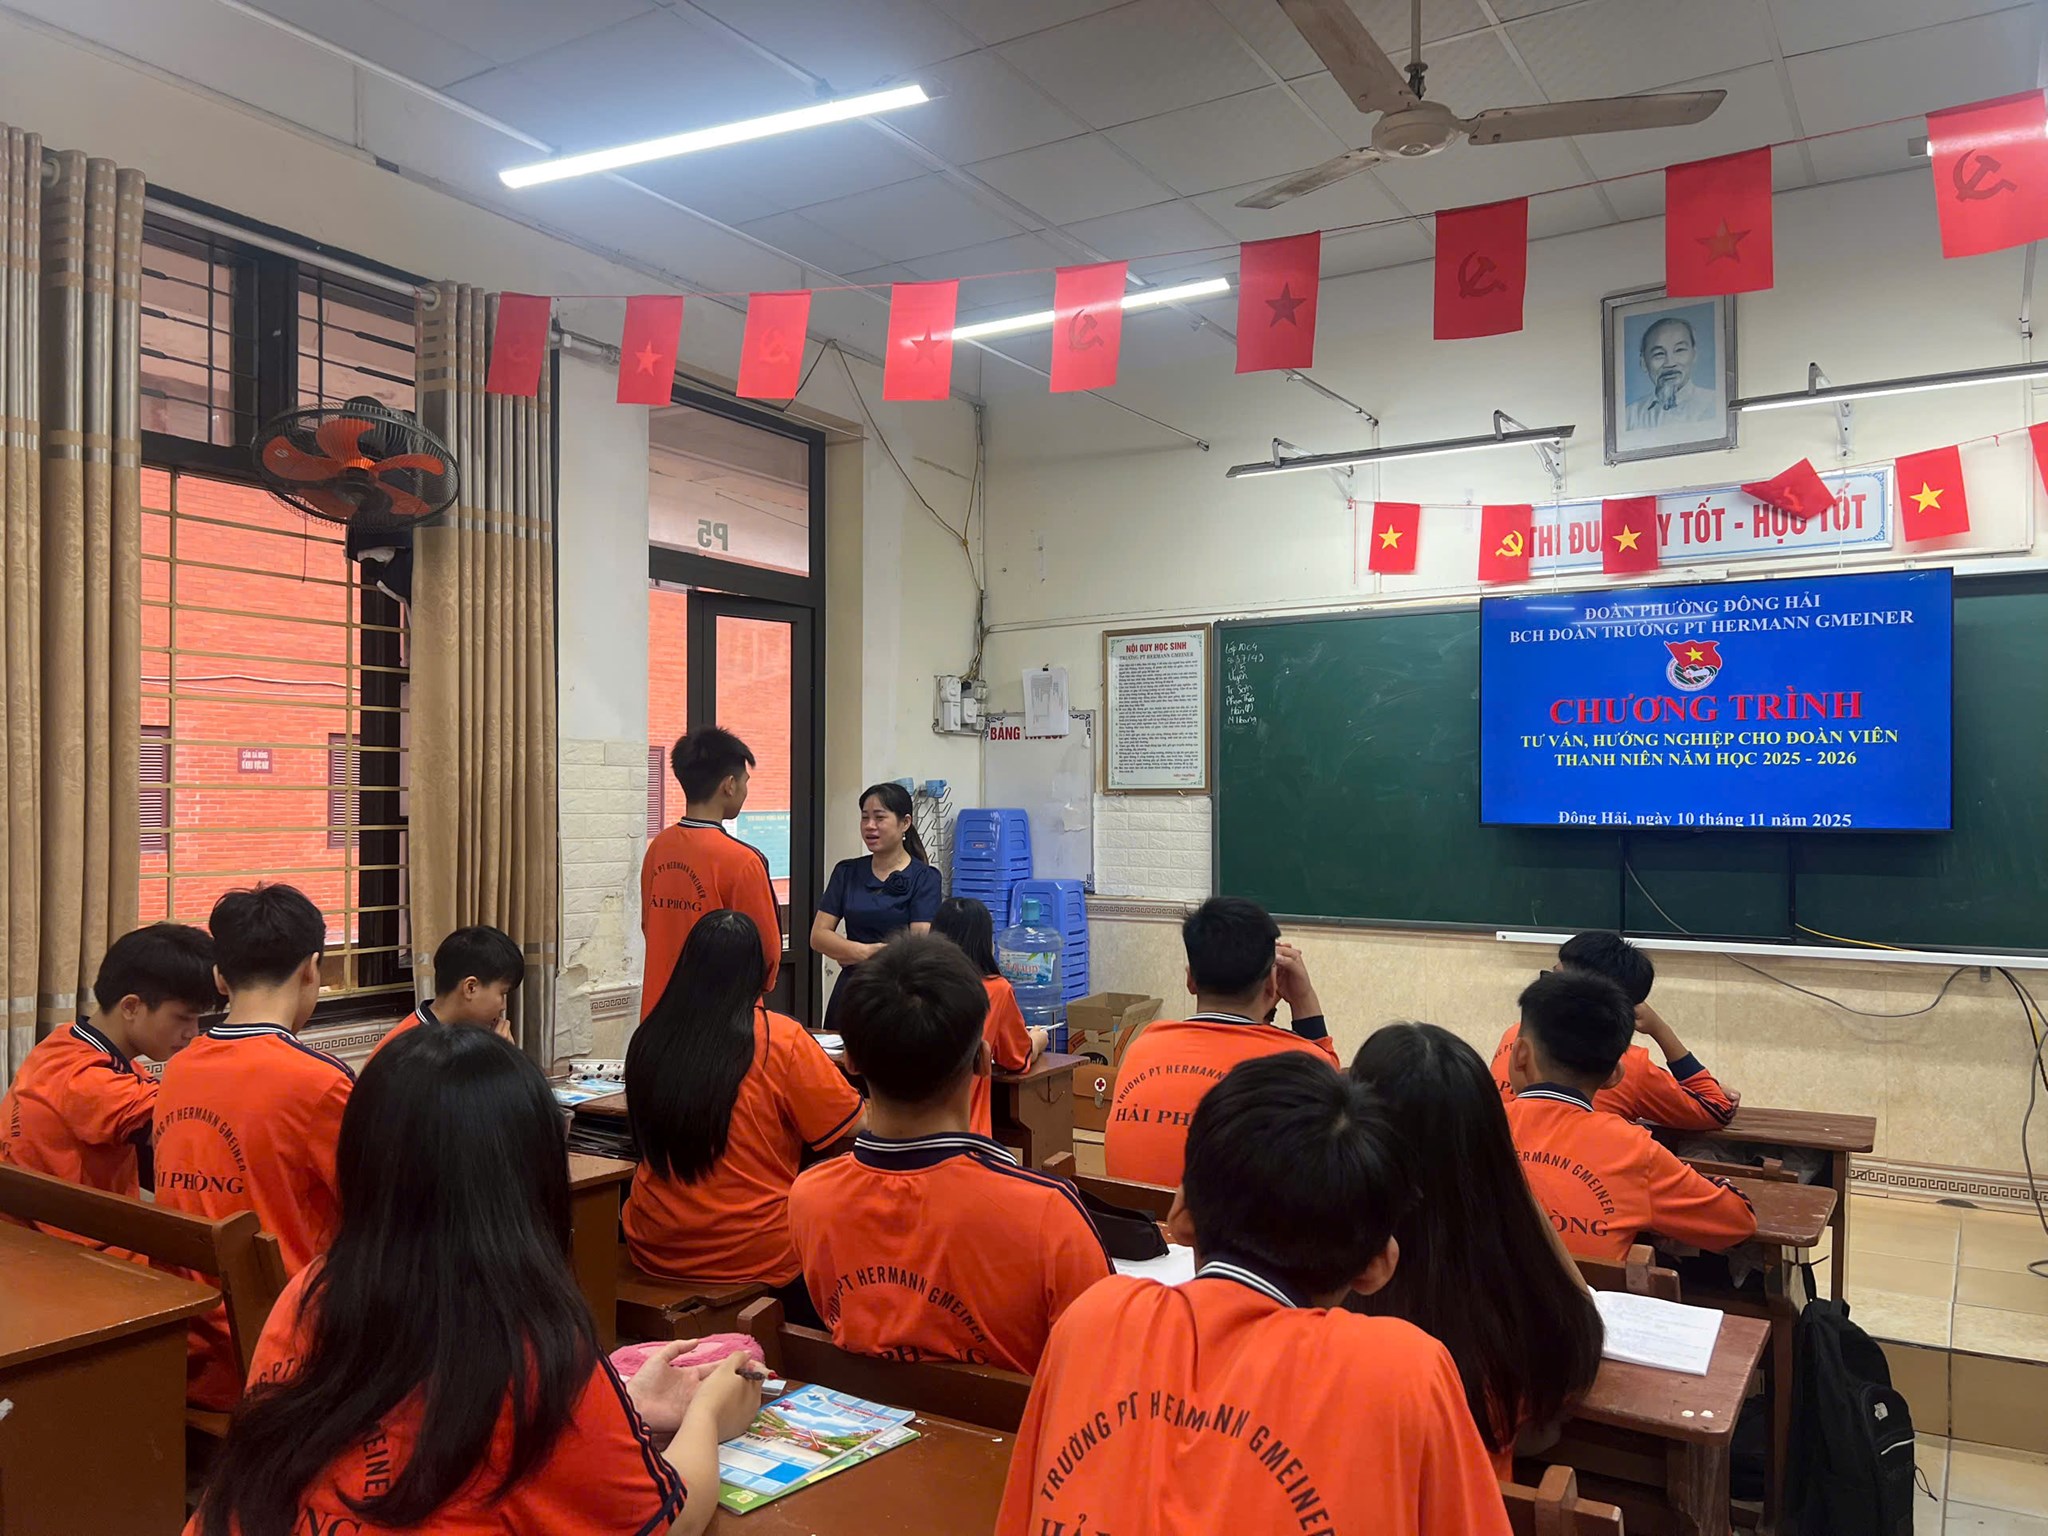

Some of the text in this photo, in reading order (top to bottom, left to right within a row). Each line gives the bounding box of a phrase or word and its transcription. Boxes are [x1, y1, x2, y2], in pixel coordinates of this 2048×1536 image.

[1680, 497, 1726, 546] TỐT
[1568, 520, 1603, 554] ĐU
[1584, 591, 1822, 620] ĐOÀN PHƯỜNG ĐÔNG HẢI
[1509, 610, 1915, 643] BCH ĐOÀN TRƯỜNG PT HERMANN GMEINER
[1126, 641, 1187, 654] NỘI QUY HỌC SINH
[1549, 685, 1863, 725] CHƯƠNG TRÌNH
[990, 721, 1021, 740] BẢNG
[1520, 726, 1899, 749] TƯ VẤN, HƯỚNG NGHIỆP CHO ĐOÀN VIÊN
[1554, 753, 1616, 767] THANH
[1620, 749, 1664, 767] NIÊN
[1668, 749, 1712, 766] NĂM
[1716, 751, 1758, 769] HỌC
[1762, 751, 1801, 766] 2025
[1816, 751, 1858, 765] 2026
[1557, 810, 1852, 827] Đông Hải, ngày 10 tháng 11 năm 2025
[650, 894, 664, 908] ẢI
[1149, 1066, 1162, 1077] PT
[1166, 1064, 1227, 1081] HERMANN
[177, 1106, 220, 1128] HERMANN
[1115, 1103, 1151, 1122] HẢI
[170, 1169, 245, 1194] PHÒNG
[1515, 1150, 1615, 1216] ERMANN GMEINER
[1550, 1209, 1609, 1237] ÒNG
[856, 1265, 928, 1296] HERMANN
[928, 1287, 987, 1344] GMEINER
[1041, 1410, 1113, 1502] TRƯỜNG
[1117, 1390, 1139, 1427] PT
[362, 1426, 391, 1502] EINE
